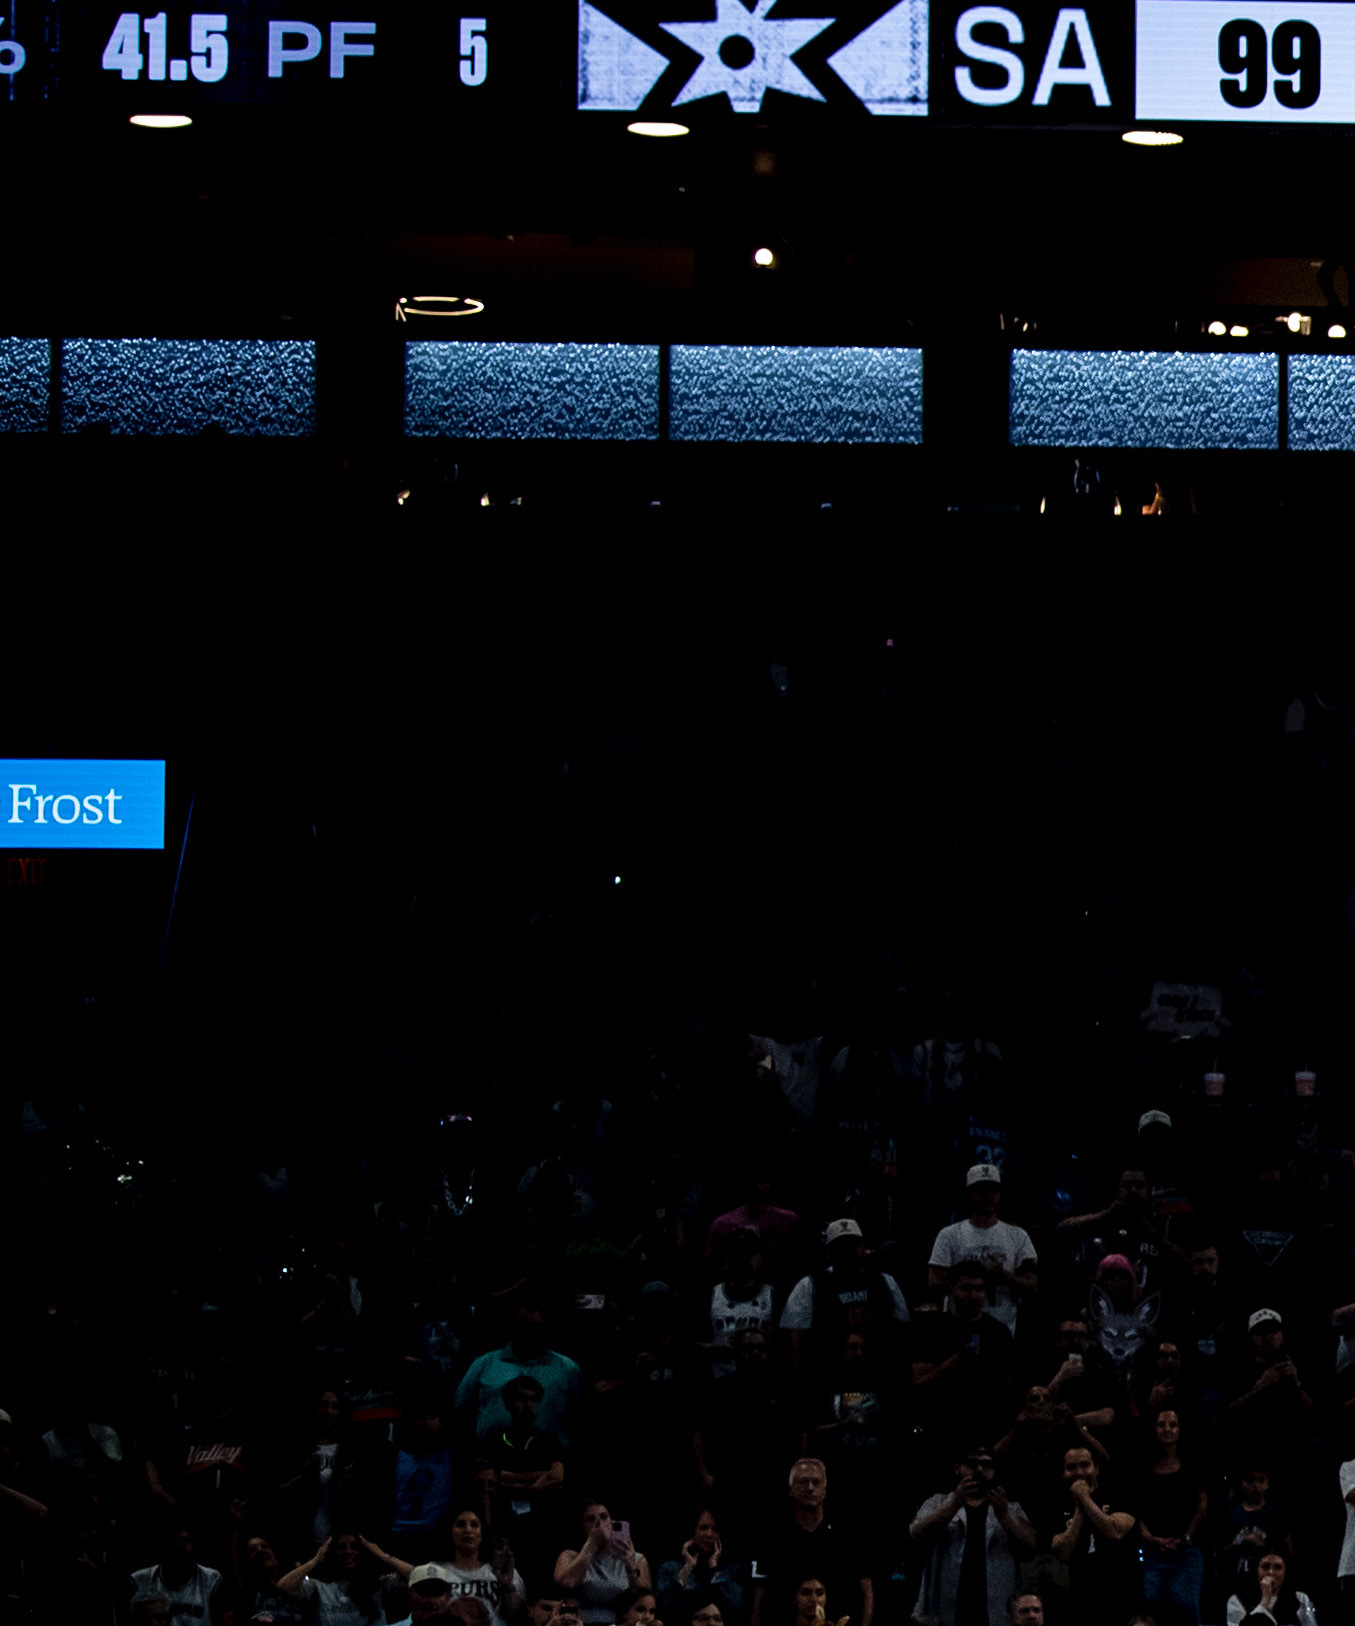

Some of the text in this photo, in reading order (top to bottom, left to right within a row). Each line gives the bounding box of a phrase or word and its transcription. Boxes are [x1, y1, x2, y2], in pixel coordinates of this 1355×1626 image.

[102, 12, 228, 82] 41.5
[268, 21, 376, 78] PF
[459, 18, 487, 86] 5
[954, 6, 1111, 106] SA
[1219, 19, 1320, 108] 99
[8, 785, 122, 824] Frost
